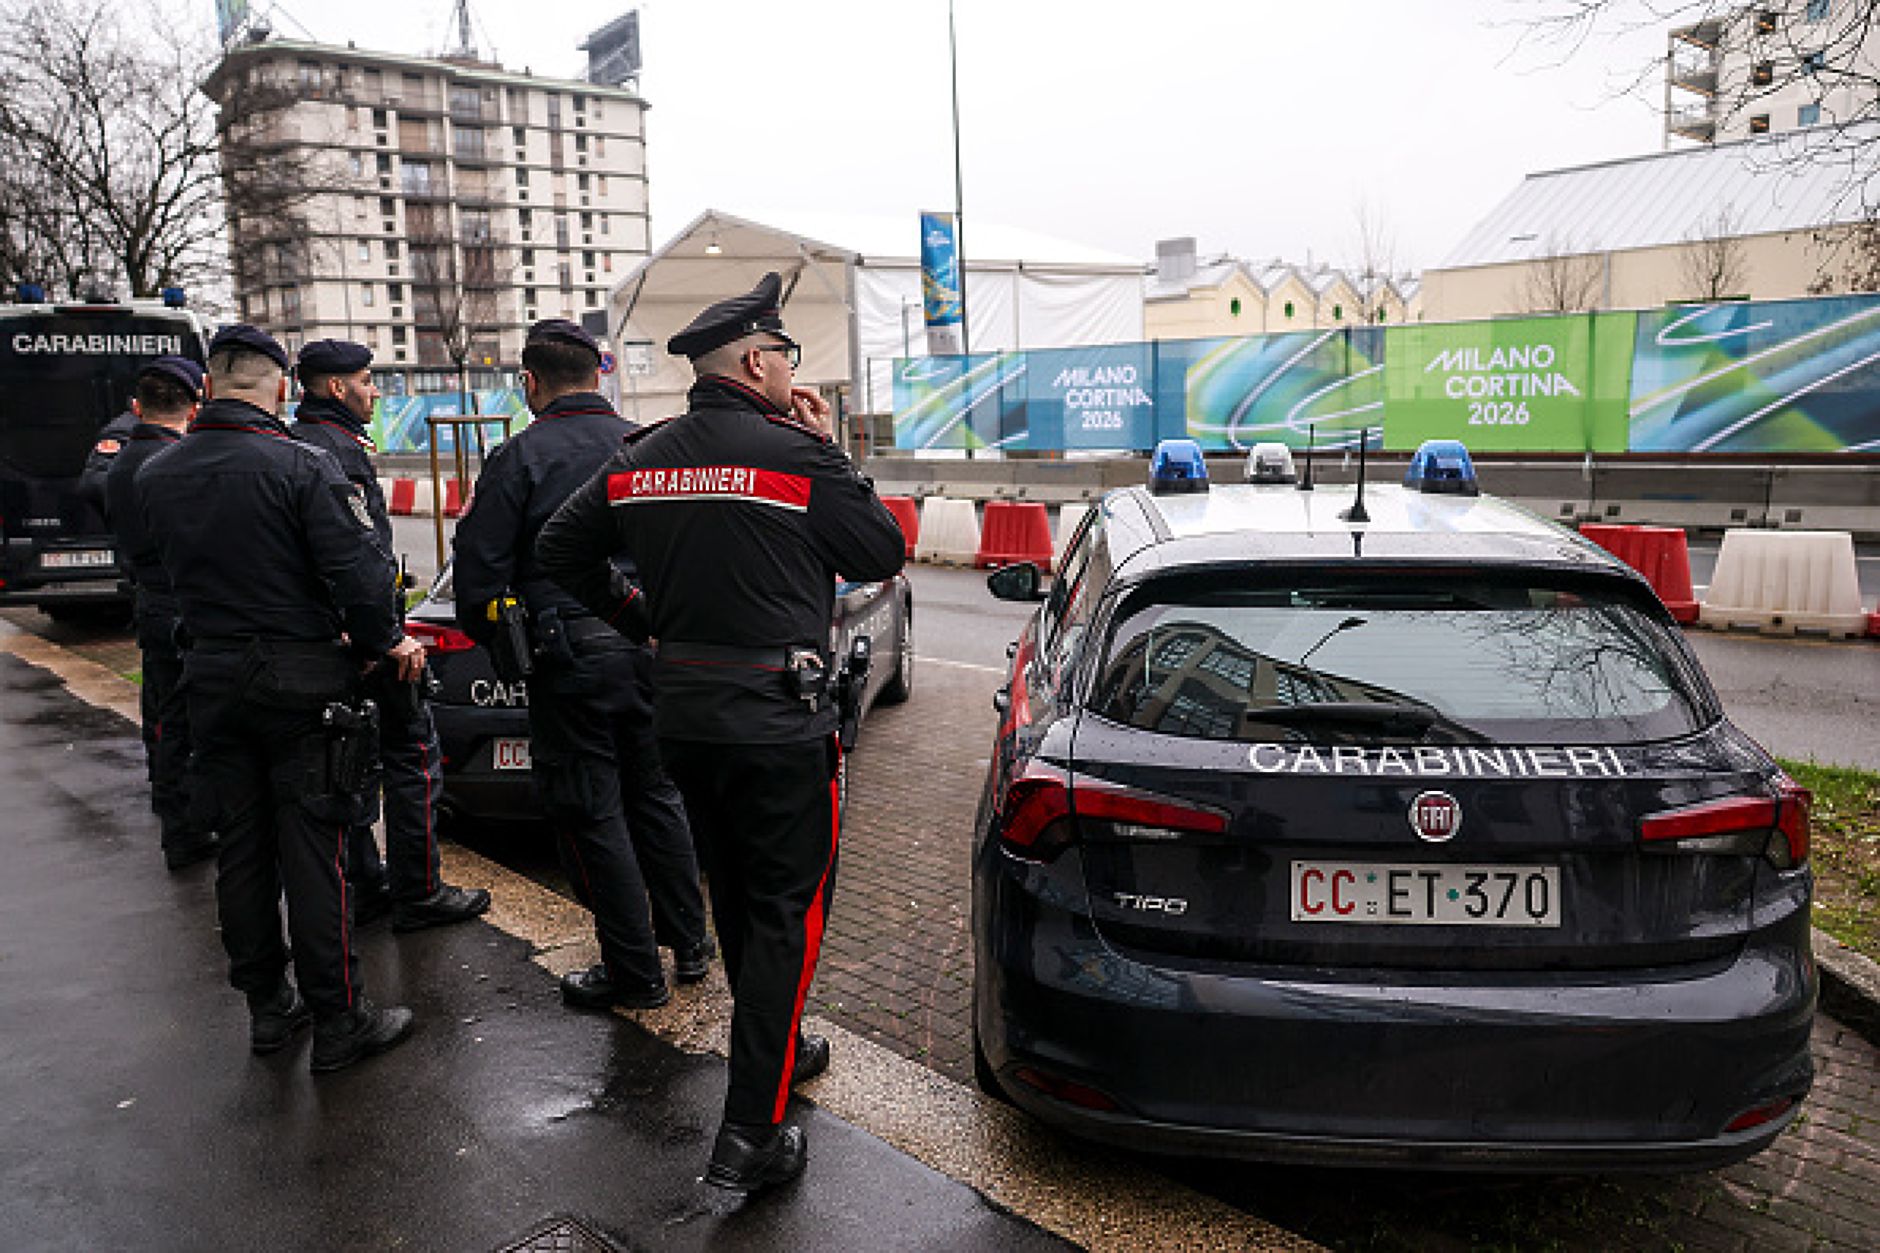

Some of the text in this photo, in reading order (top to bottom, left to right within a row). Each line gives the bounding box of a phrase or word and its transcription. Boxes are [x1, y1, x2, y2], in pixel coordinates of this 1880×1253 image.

[12, 334, 182, 354] CARABINIERI
[1424, 345, 1555, 373] MILANO
[1051, 365, 1137, 388] MILANO
[1446, 373, 1580, 399] CORTINA
[1066, 387, 1153, 408] CORTINA
[1081, 410, 1124, 430] 2026
[1468, 401, 1530, 425] 2026
[631, 468, 757, 494] CARABINIERI
[499, 742, 527, 766] CC
[1249, 743, 1627, 775] CARABINIERI
[1113, 891, 1187, 915] TIPO
[1300, 869, 1549, 918] CC ET 370
